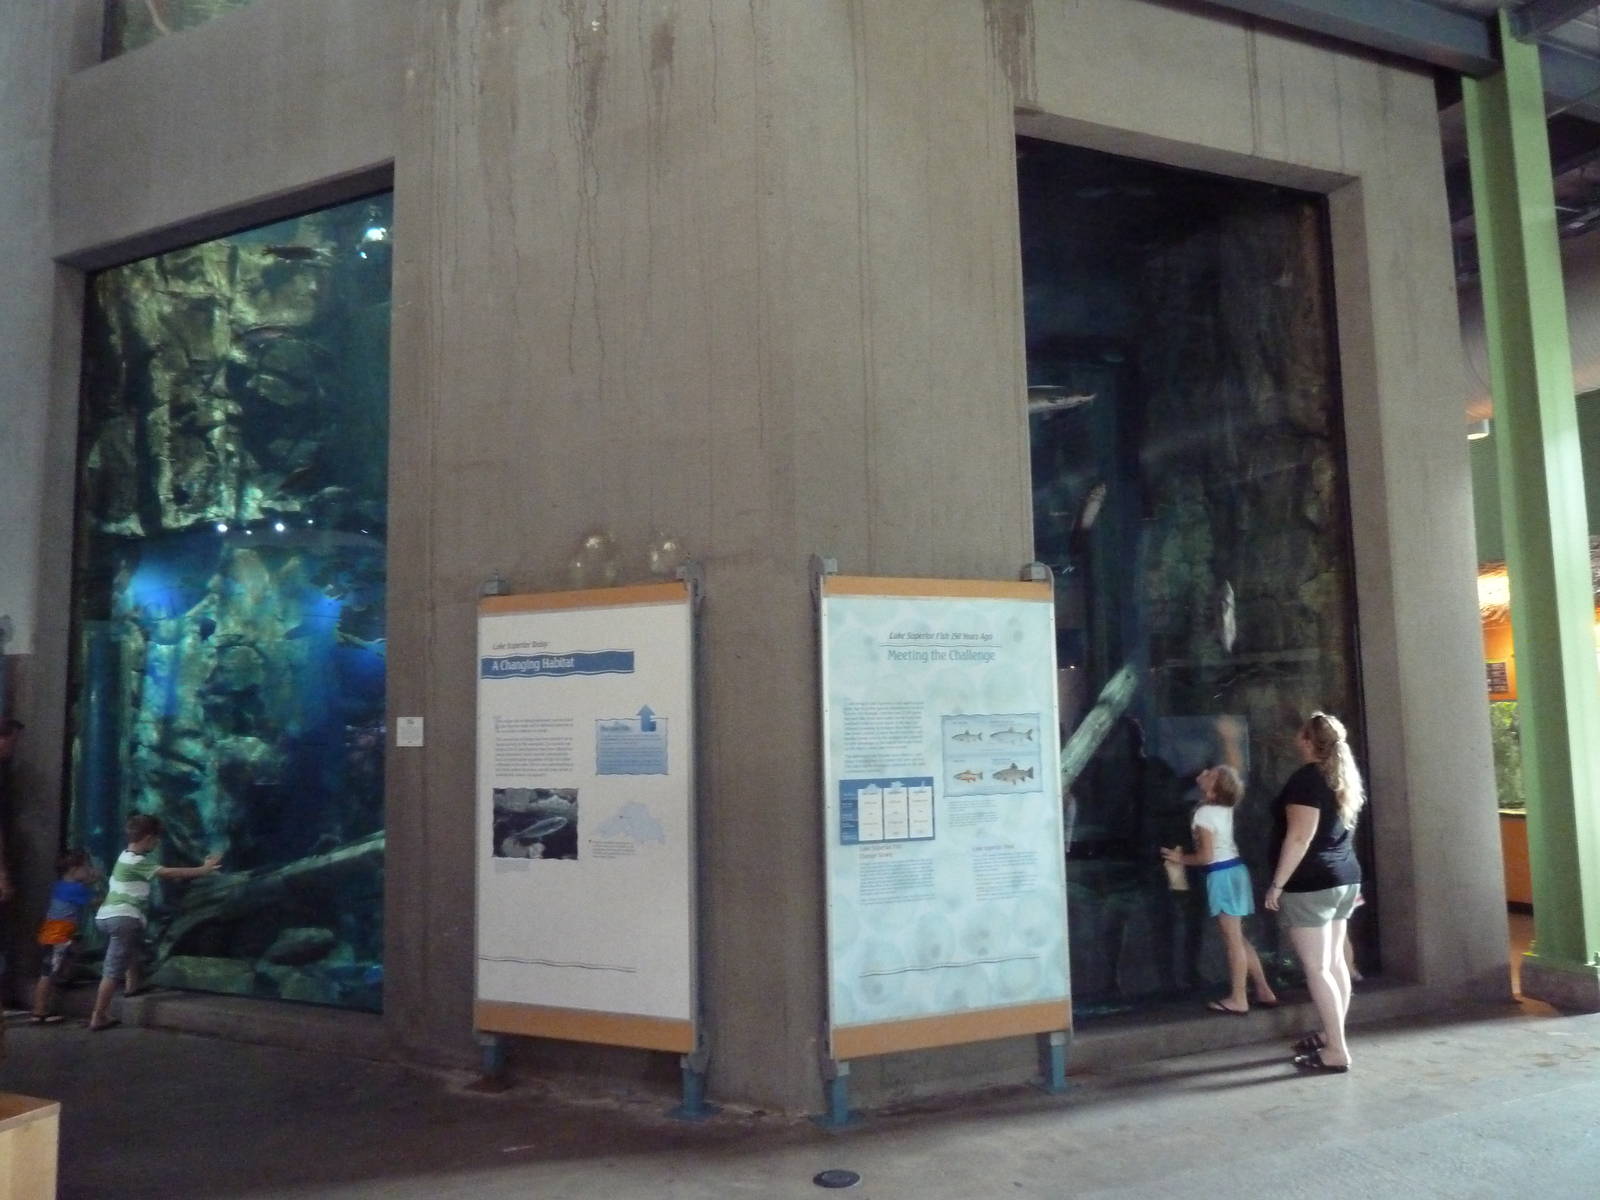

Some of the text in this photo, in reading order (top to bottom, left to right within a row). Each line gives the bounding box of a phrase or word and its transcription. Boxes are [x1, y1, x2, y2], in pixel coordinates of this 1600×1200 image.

[888, 650, 995, 664] Meeting the Challenge
[492, 657, 575, 672] A Changing Habitat
